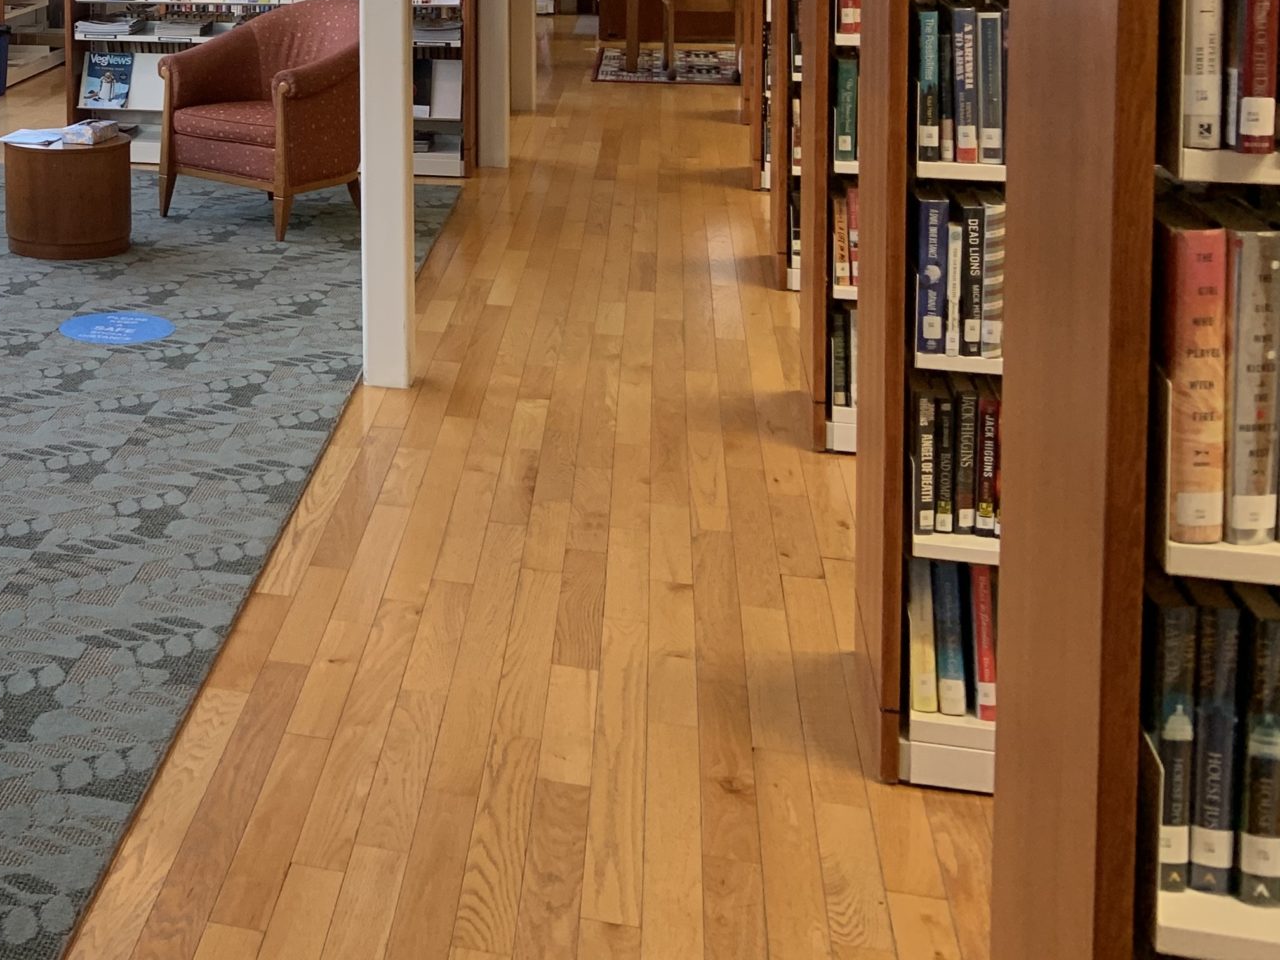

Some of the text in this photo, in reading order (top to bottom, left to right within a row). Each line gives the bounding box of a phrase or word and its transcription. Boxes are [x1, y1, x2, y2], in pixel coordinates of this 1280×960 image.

[924, 18, 934, 33] The
[954, 31, 964, 46] TO
[963, 23, 973, 32] A
[91, 53, 132, 66] VegNews
[963, 34, 974, 90] FAREWELL
[968, 218, 979, 245] DEAD
[969, 247, 980, 276] LIONS
[1196, 252, 1213, 263] THE
[984, 414, 994, 438] JACK
[1192, 411, 1217, 422] FIRE
[960, 394, 977, 468] JACK HIGGINS
[921, 434, 933, 502] ANGEL OF DEATH
[983, 440, 993, 478] HIGGINS
[940, 452, 951, 501] BAD COMP
[1206, 751, 1223, 803] HOUSE
